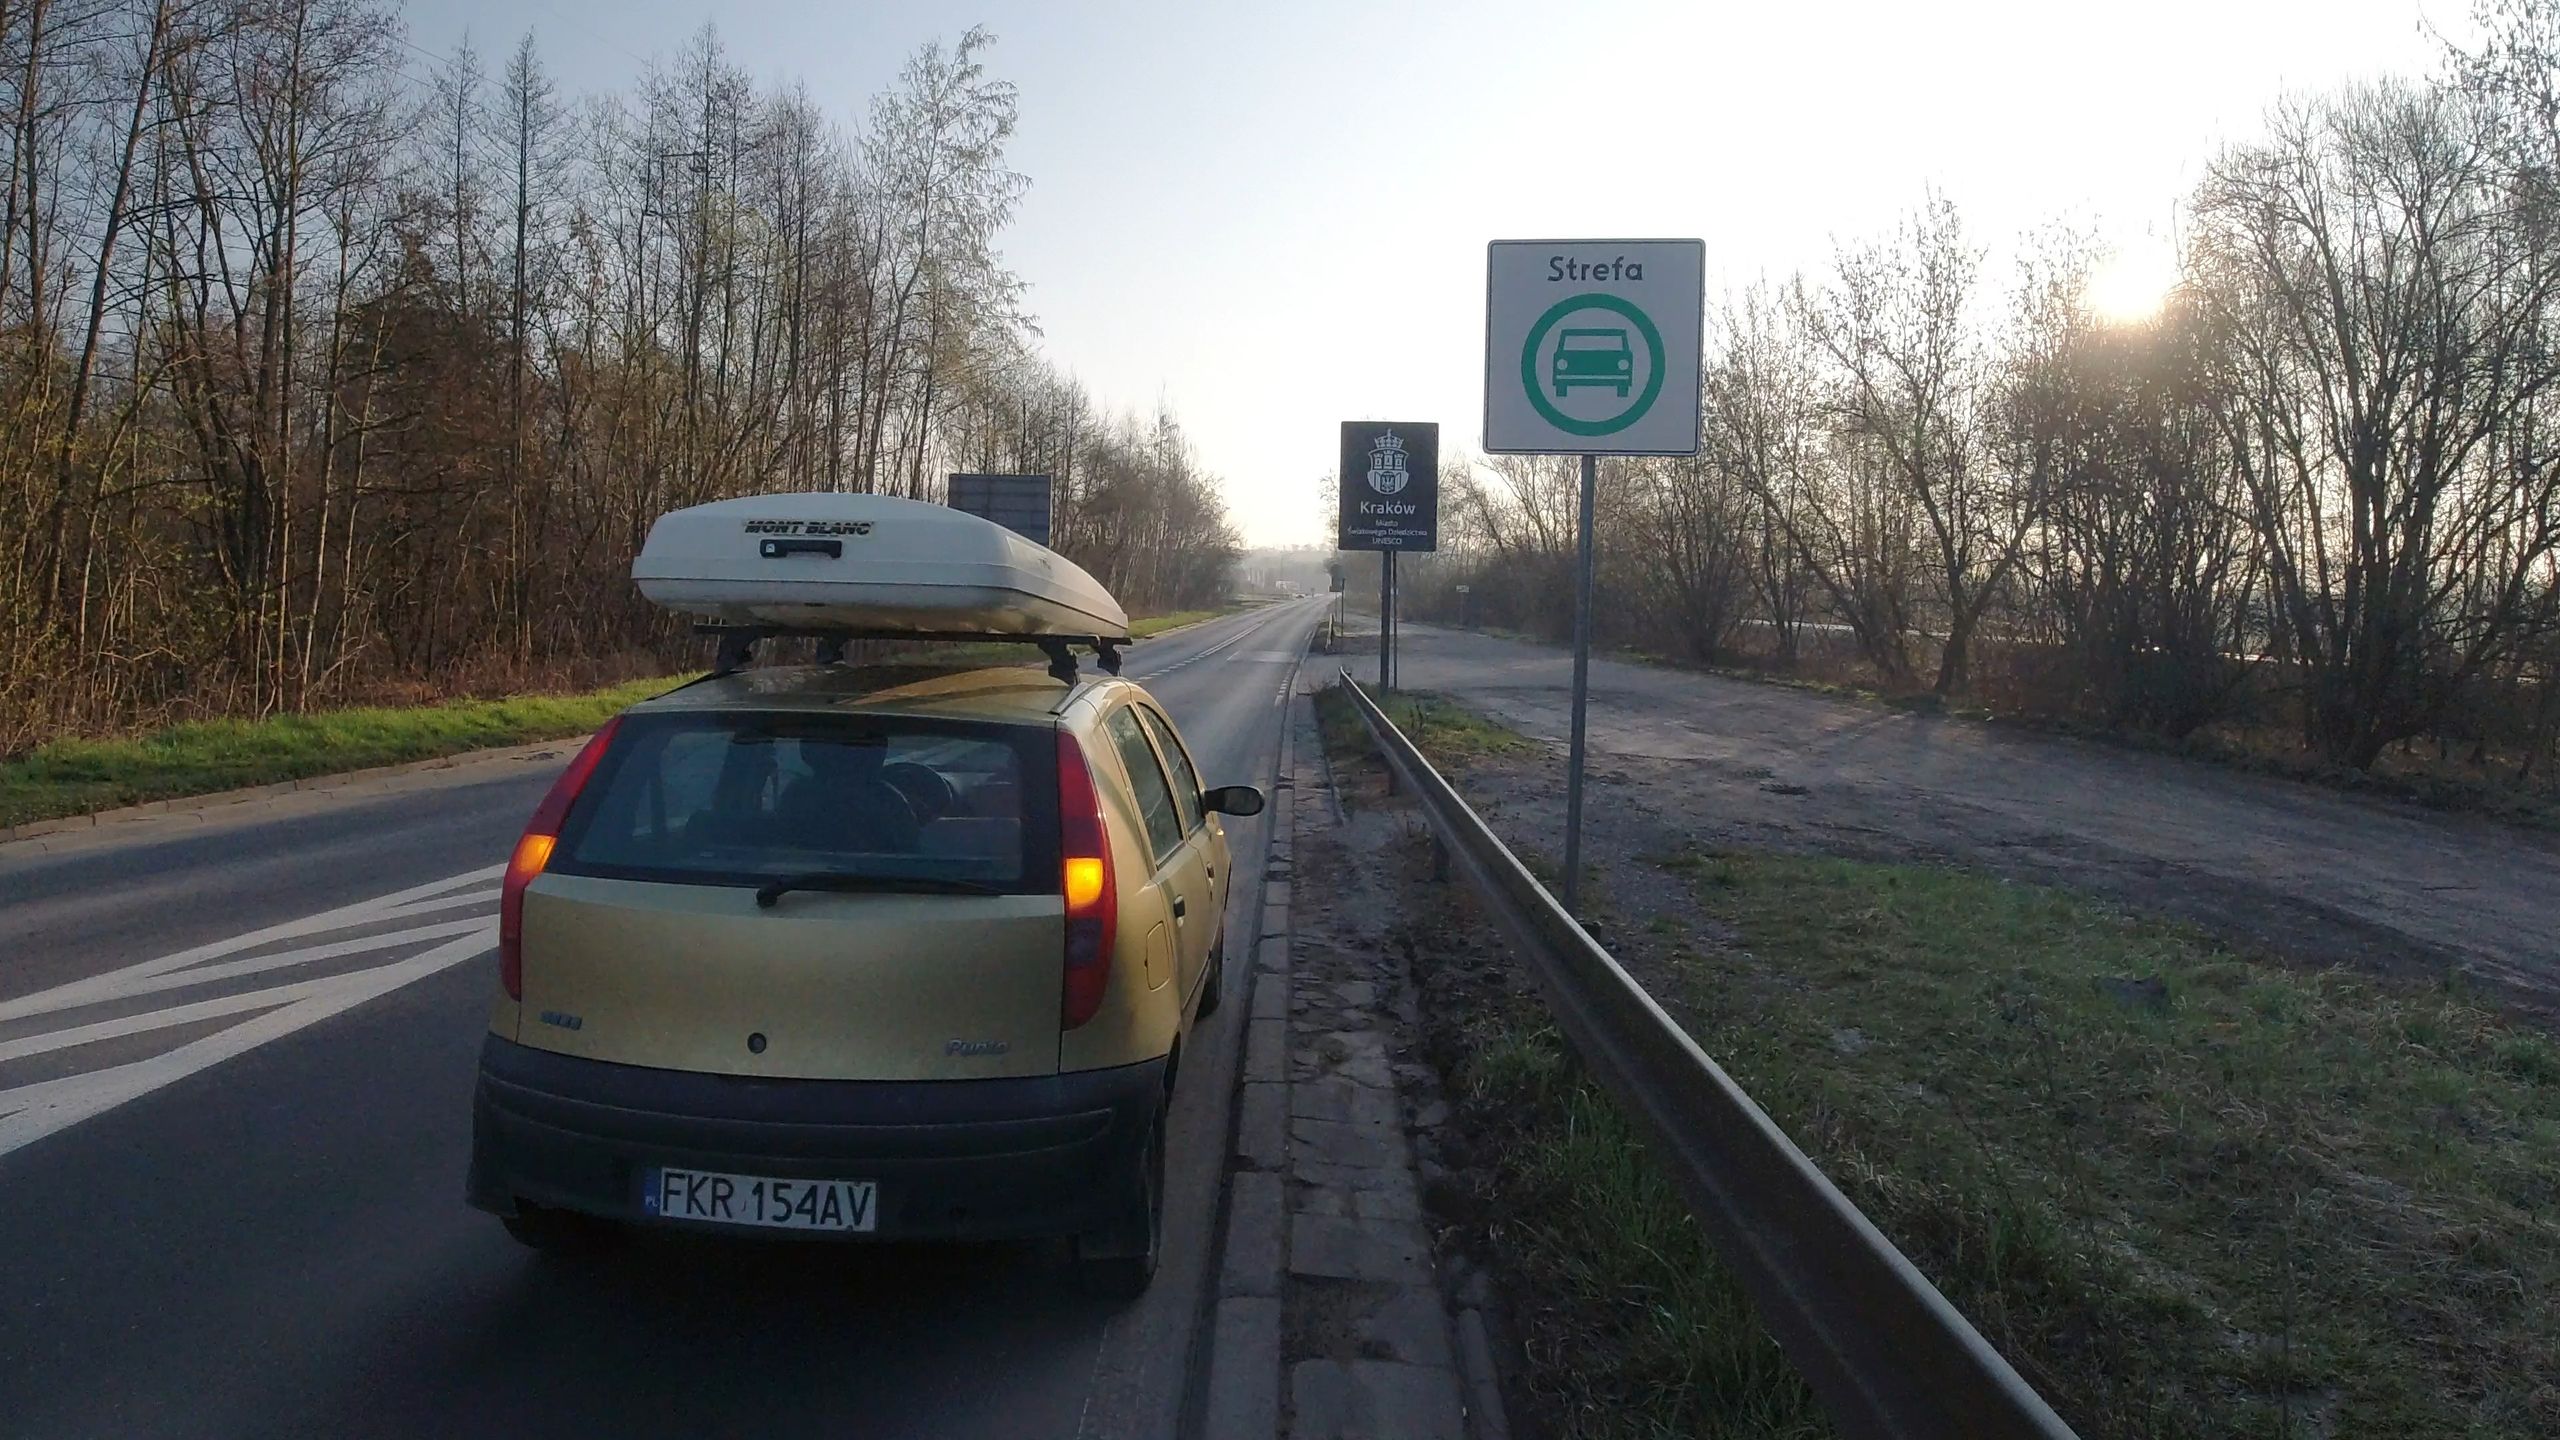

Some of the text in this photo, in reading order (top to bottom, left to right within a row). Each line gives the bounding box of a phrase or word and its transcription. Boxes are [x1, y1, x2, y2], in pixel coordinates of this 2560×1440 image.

[1547, 256, 1643, 282] Strefa
[1360, 501, 1416, 515] Kraków
[744, 520, 871, 536] MONT BLANC
[661, 1171, 735, 1219] FKR
[751, 1181, 871, 1227] 154AV
